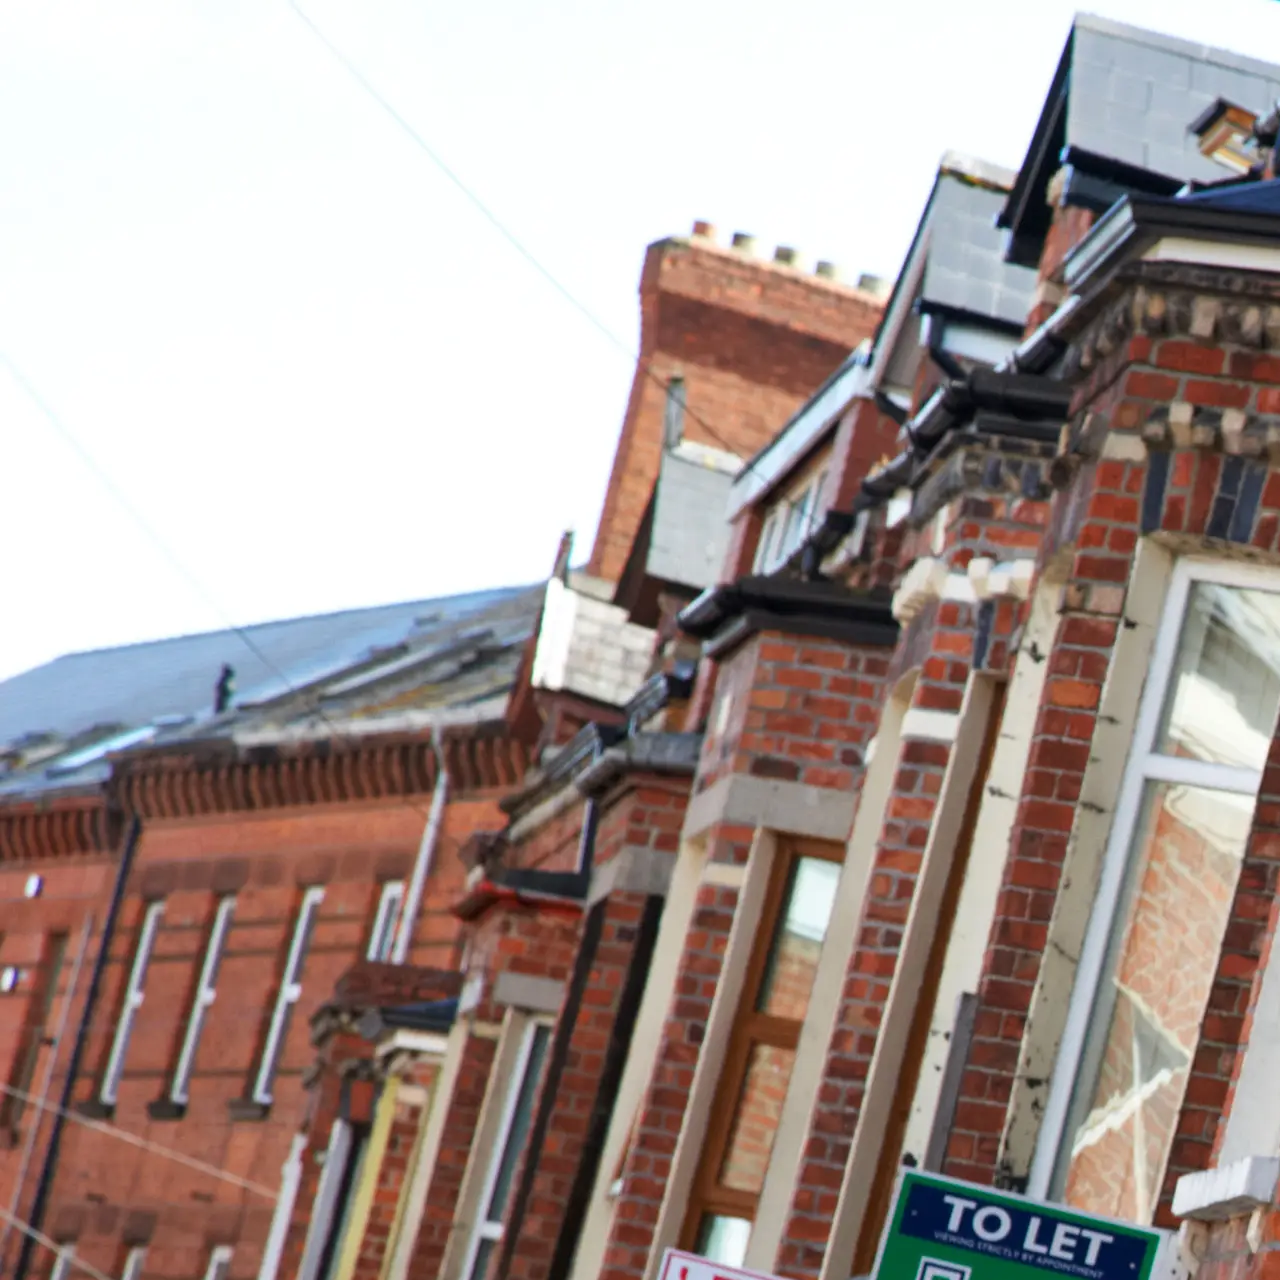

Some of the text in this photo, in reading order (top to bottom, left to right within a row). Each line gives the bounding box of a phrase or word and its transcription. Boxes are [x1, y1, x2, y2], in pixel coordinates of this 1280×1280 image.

[934, 1230, 975, 1249] VIEWING
[1021, 1251, 1034, 1263] BY
[1036, 1255, 1104, 1279] APPOINTMENT
[943, 1194, 1114, 1267] TO LET
